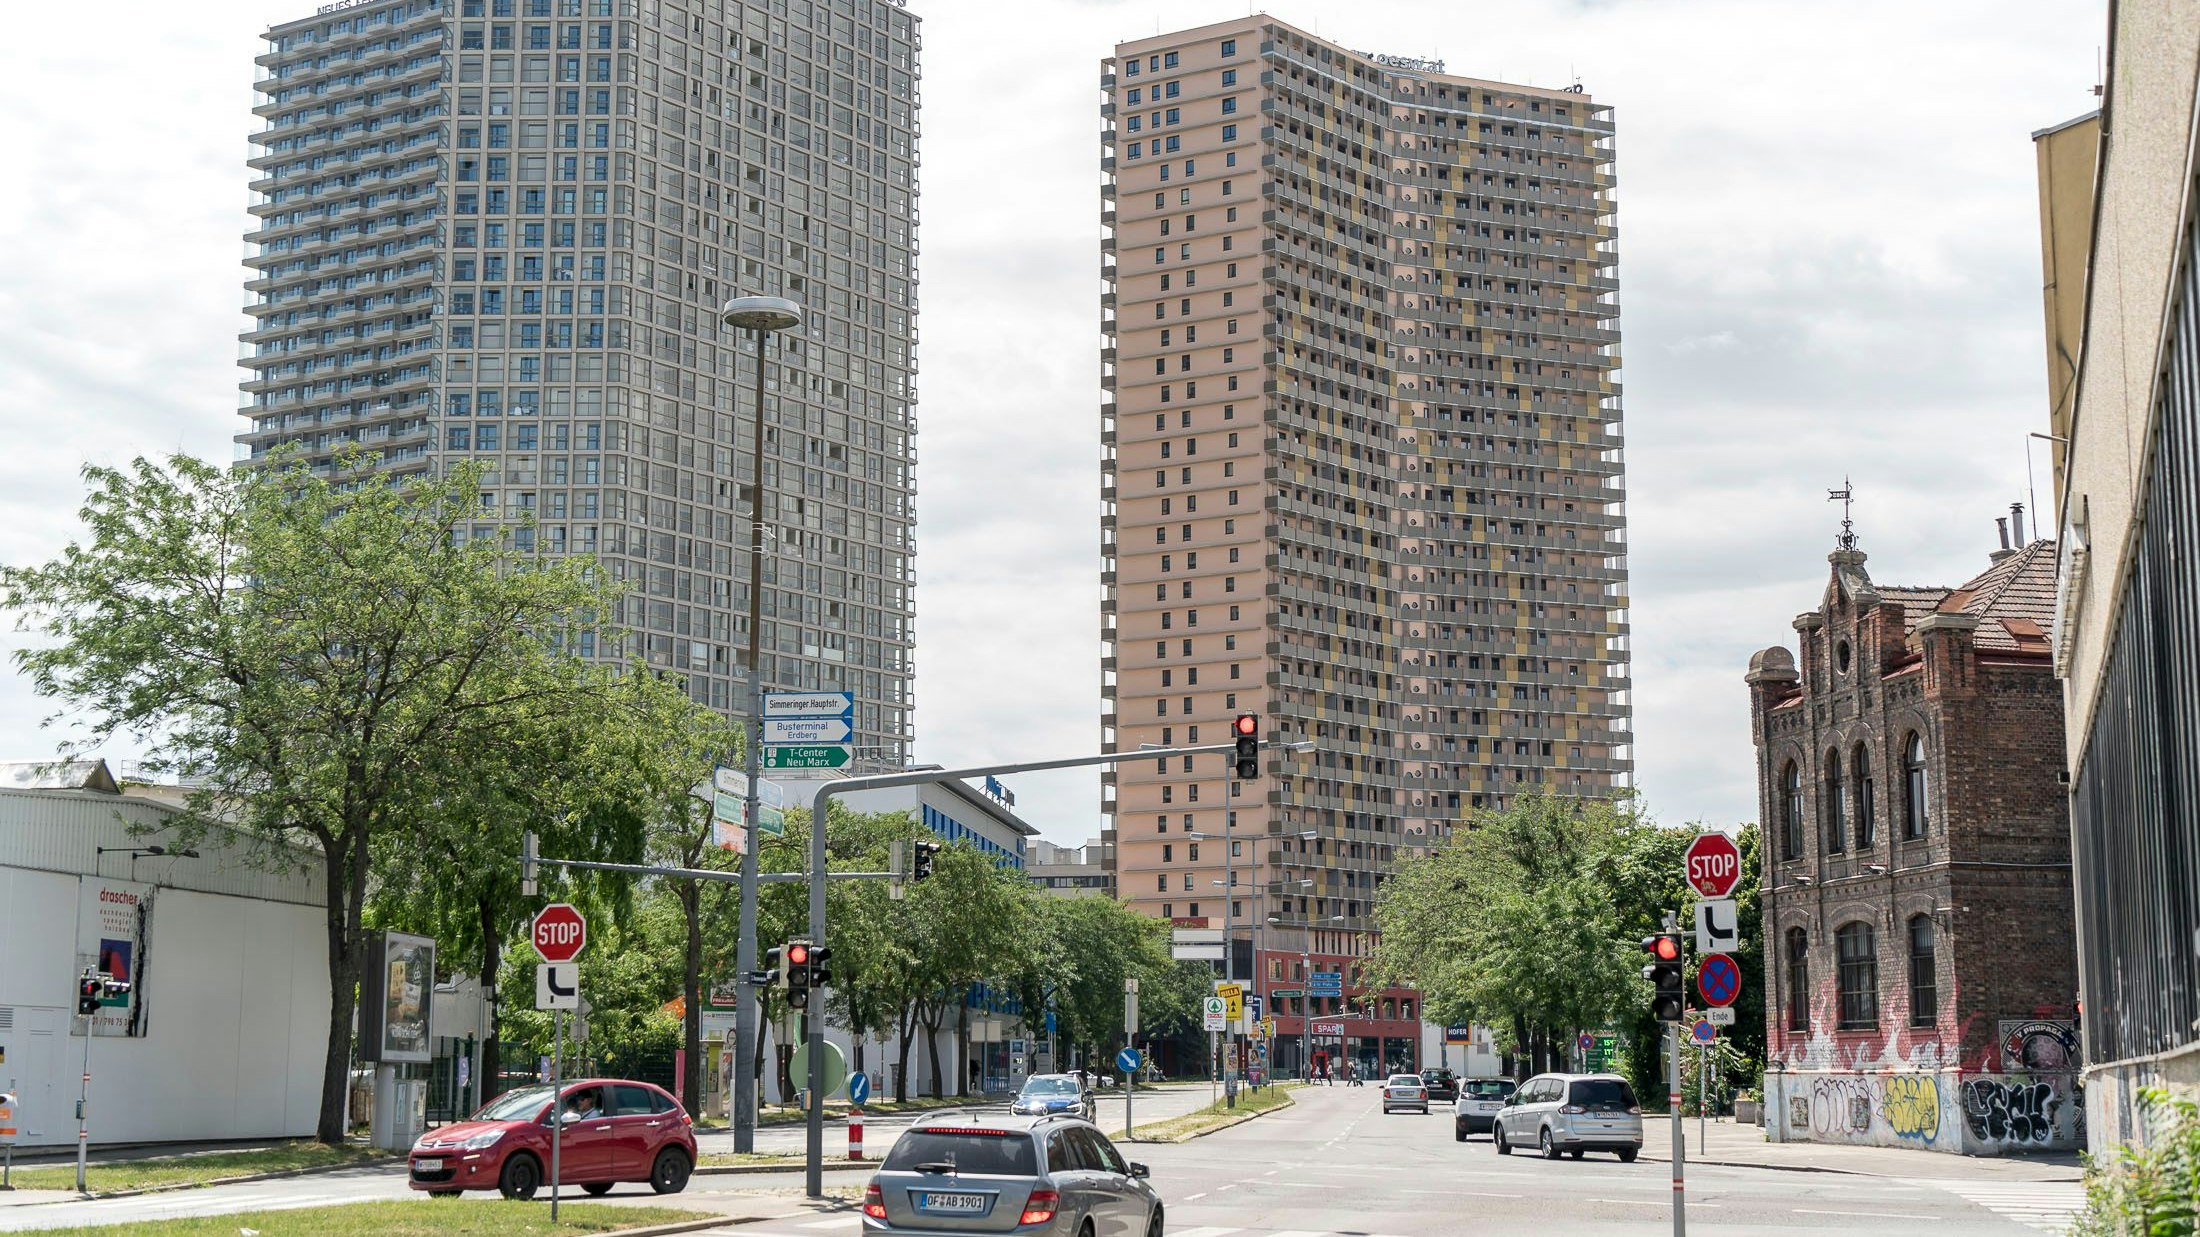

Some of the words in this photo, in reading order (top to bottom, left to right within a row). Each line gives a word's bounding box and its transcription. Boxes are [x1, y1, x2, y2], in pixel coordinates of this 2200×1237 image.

[769, 699, 810, 710] Simmeringer
[810, 698, 840, 710] Hauptstr.
[777, 722, 828, 731] Busterminal
[787, 731, 818, 740] Erdberg
[789, 748, 828, 757] T-Center
[786, 758, 804, 767] Neu
[807, 758, 830, 767] Marx
[1691, 853, 1735, 879] STOP
[100, 887, 138, 905] drascher
[538, 922, 580, 945] STOP
[1220, 987, 1239, 998] BILLA
[1712, 1012, 1729, 1021] Ende
[1317, 1025, 1337, 1033] SPAR
[928, 1195, 939, 1206] OF
[946, 1196, 958, 1207] AB
[959, 1196, 982, 1209] 1901
